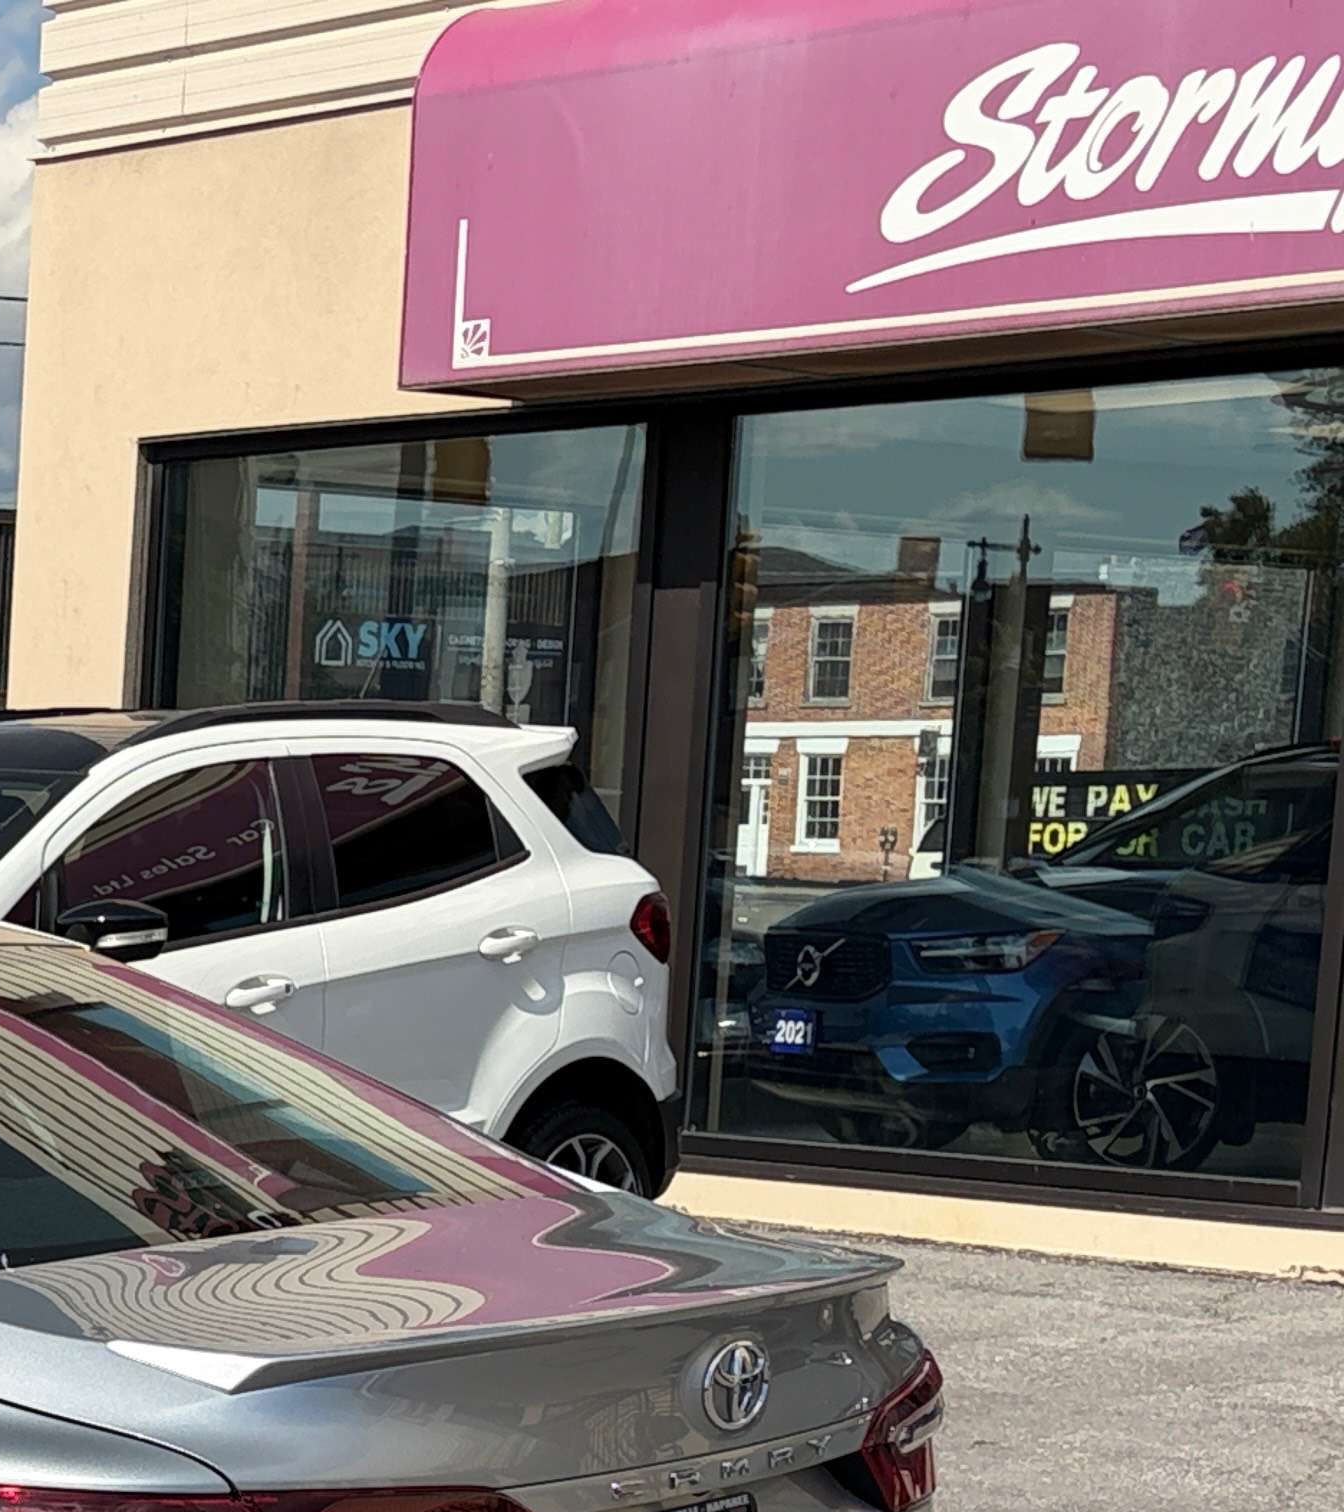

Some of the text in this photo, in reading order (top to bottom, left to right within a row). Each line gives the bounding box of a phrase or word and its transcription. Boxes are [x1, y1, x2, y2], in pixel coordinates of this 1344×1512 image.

[358, 621, 426, 659] SKY
[1032, 786, 1067, 817] WE
[774, 1019, 813, 1045] 2021
[611, 1434, 832, 1499] CAMRY
